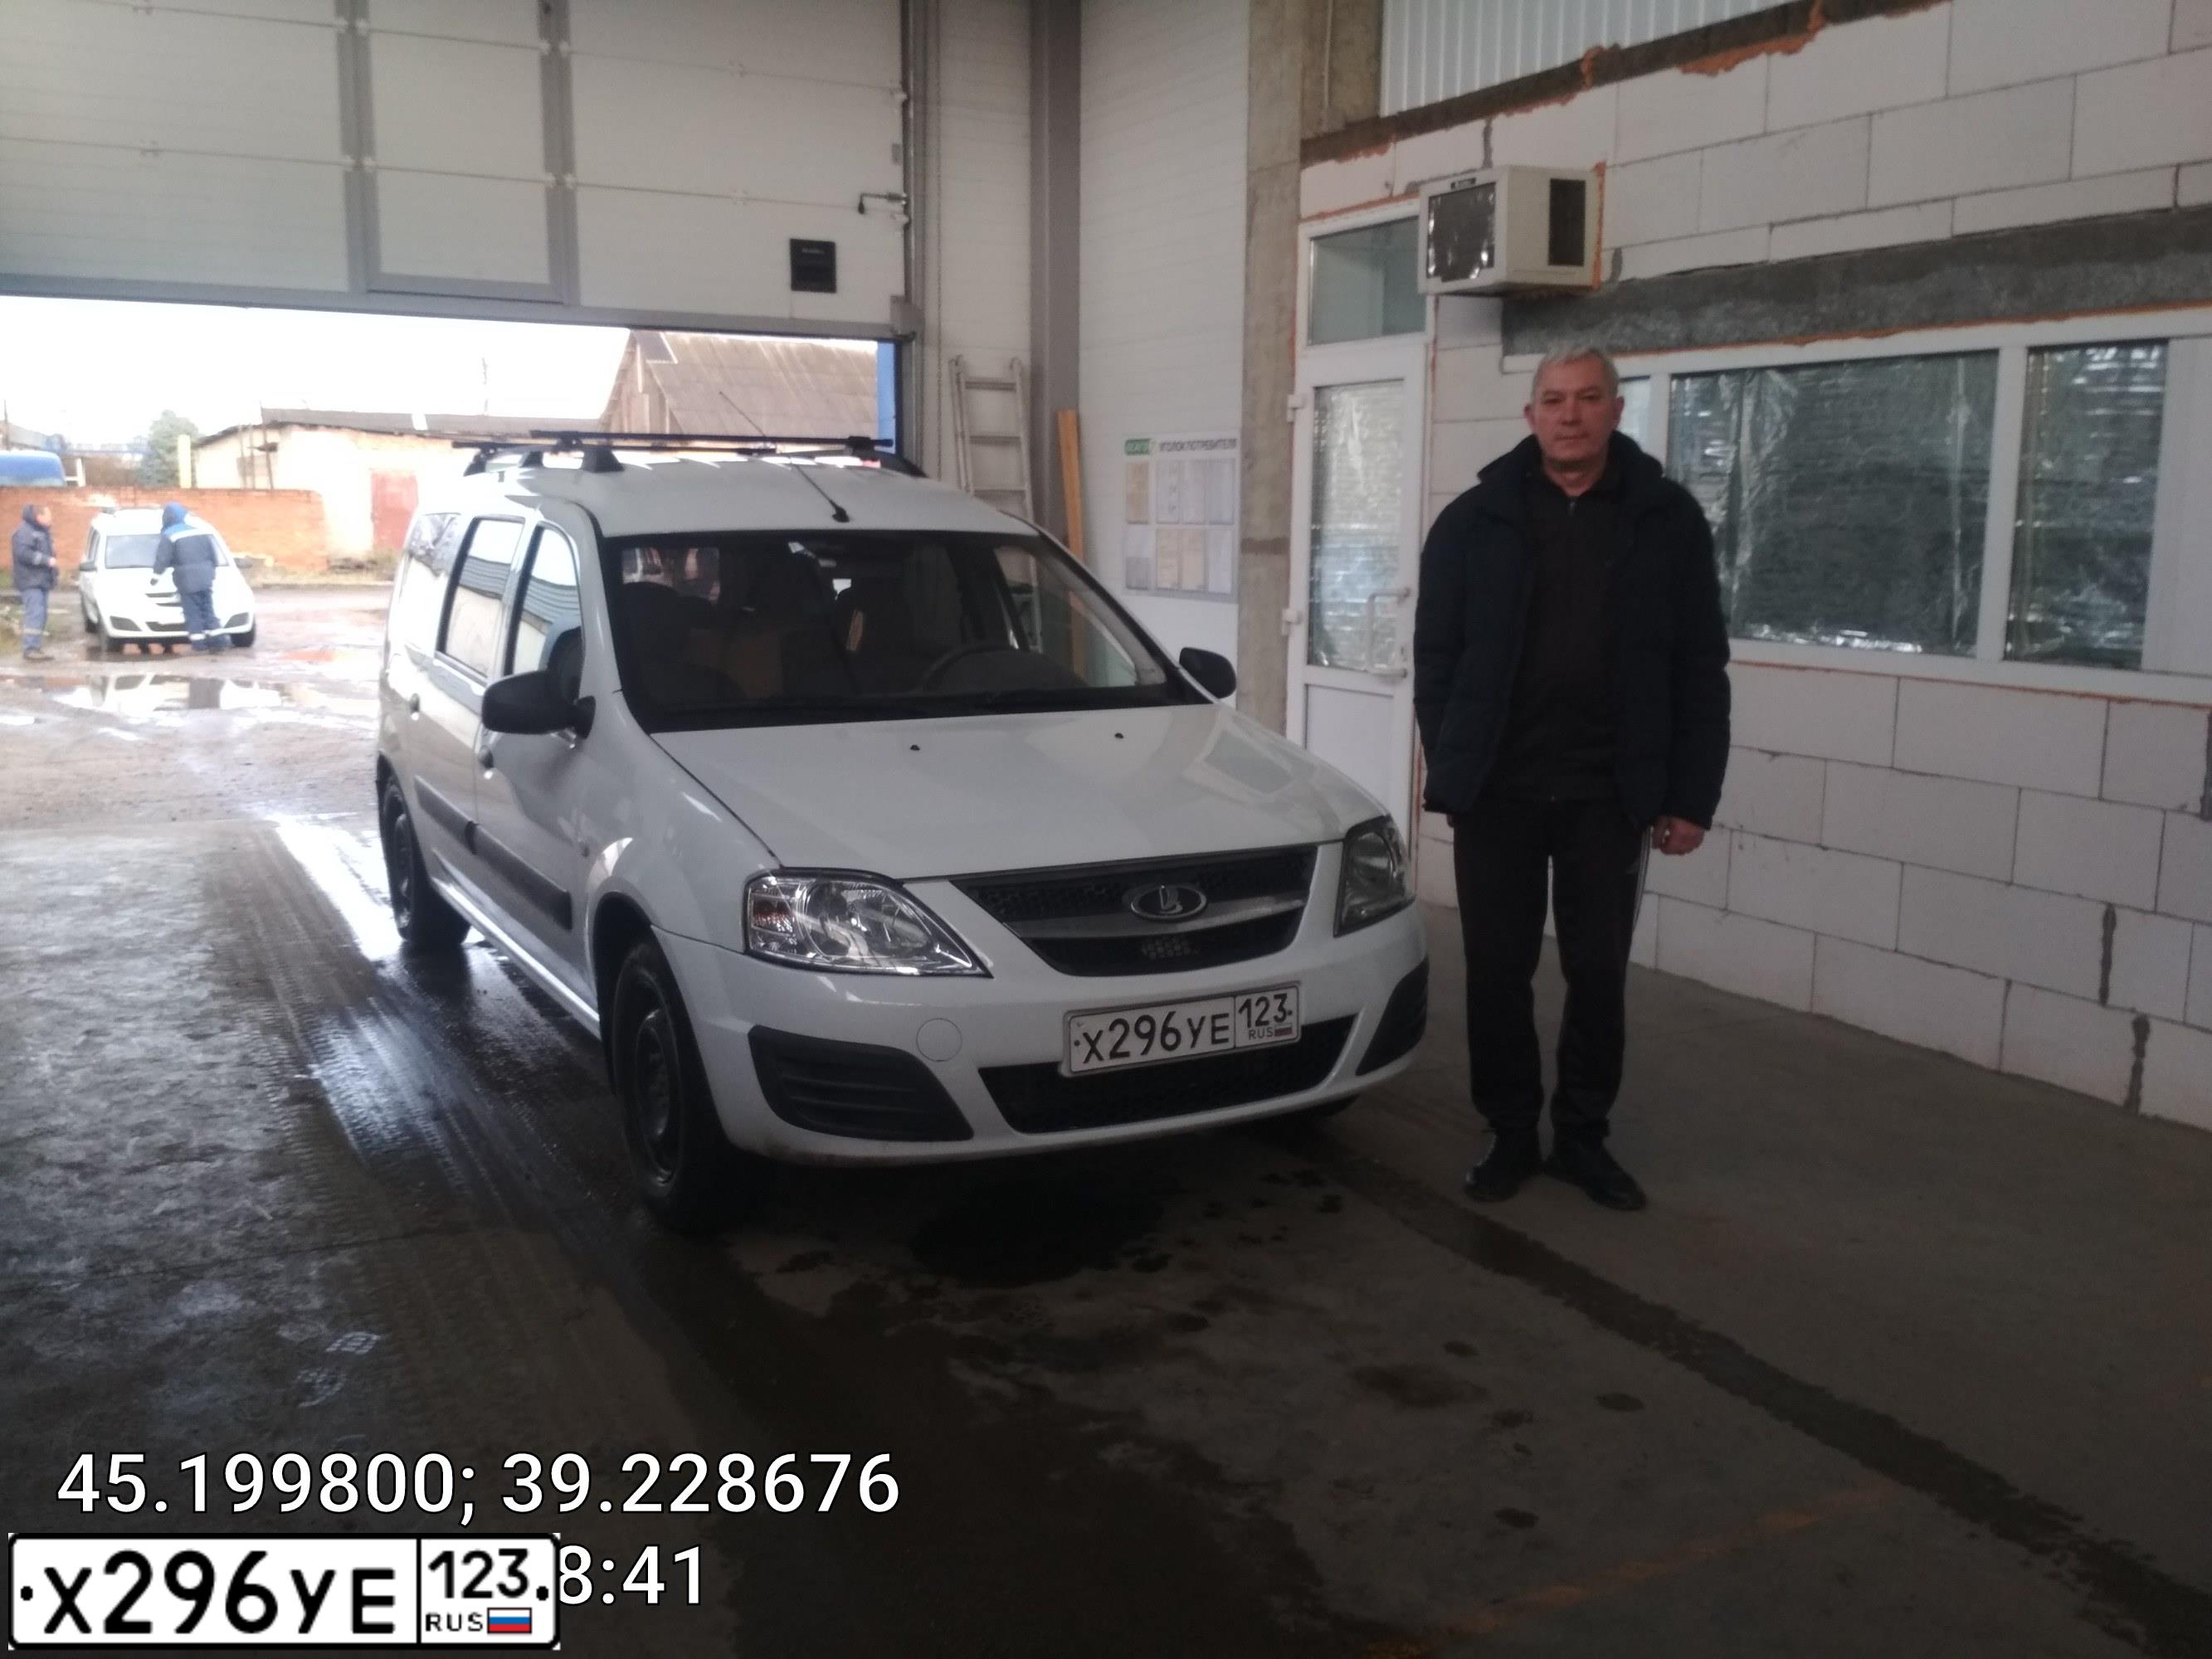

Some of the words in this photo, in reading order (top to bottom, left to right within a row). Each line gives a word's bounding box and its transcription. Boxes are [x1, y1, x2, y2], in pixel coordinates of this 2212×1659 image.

[1082, 1010, 1230, 1064] Х296УЕ
[1238, 993, 1288, 1029] 123
[1248, 1028, 1274, 1040] RUS
